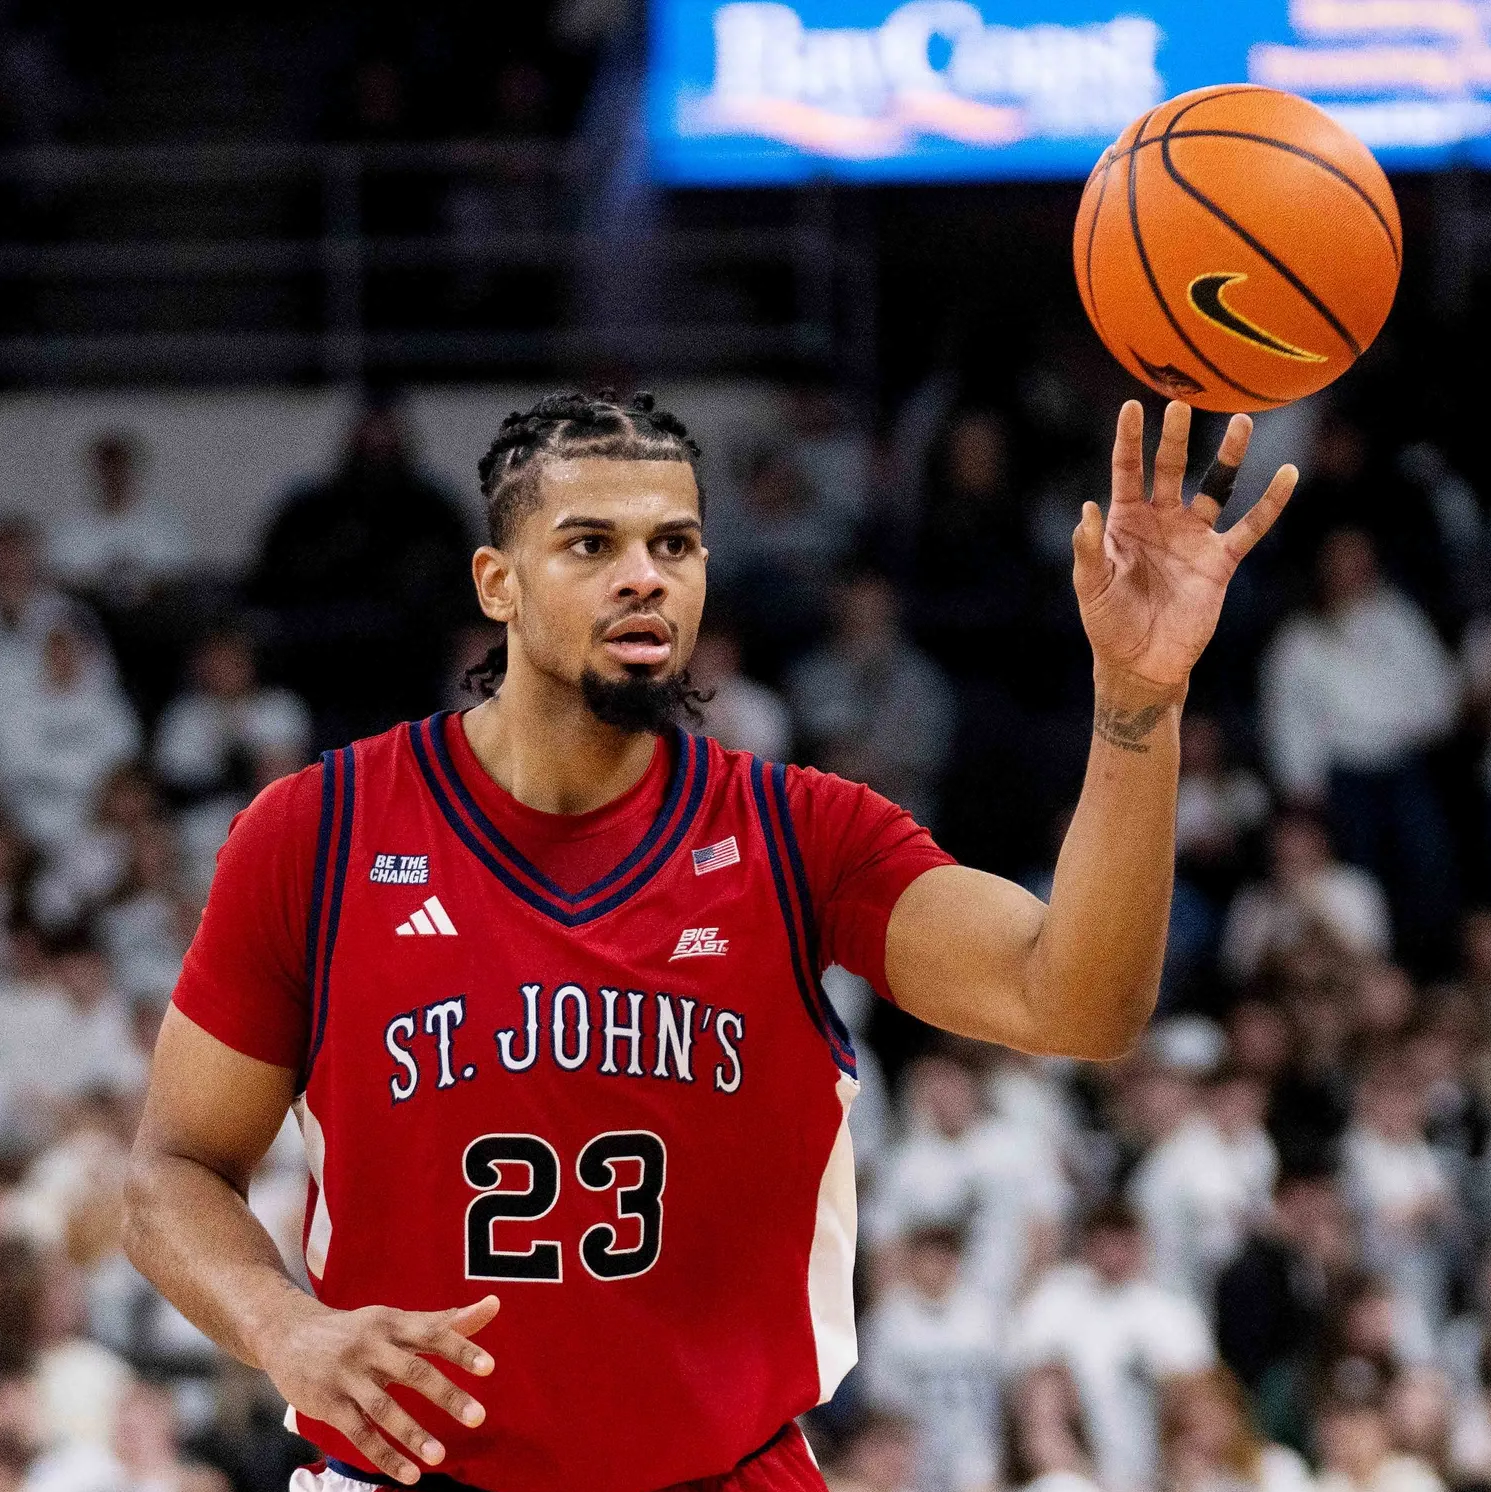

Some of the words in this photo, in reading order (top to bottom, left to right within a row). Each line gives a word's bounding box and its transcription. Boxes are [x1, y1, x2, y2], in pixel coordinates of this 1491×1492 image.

[375, 854, 396, 869] BE
[400, 855, 428, 870] THE
[369, 867, 429, 884] CHANGE
[679, 927, 719, 941] BIG
[673, 940, 729, 954] EAST
[385, 995, 477, 1104] ST.
[495, 983, 745, 1095] JOHN'S
[462, 1130, 667, 1283] 23
